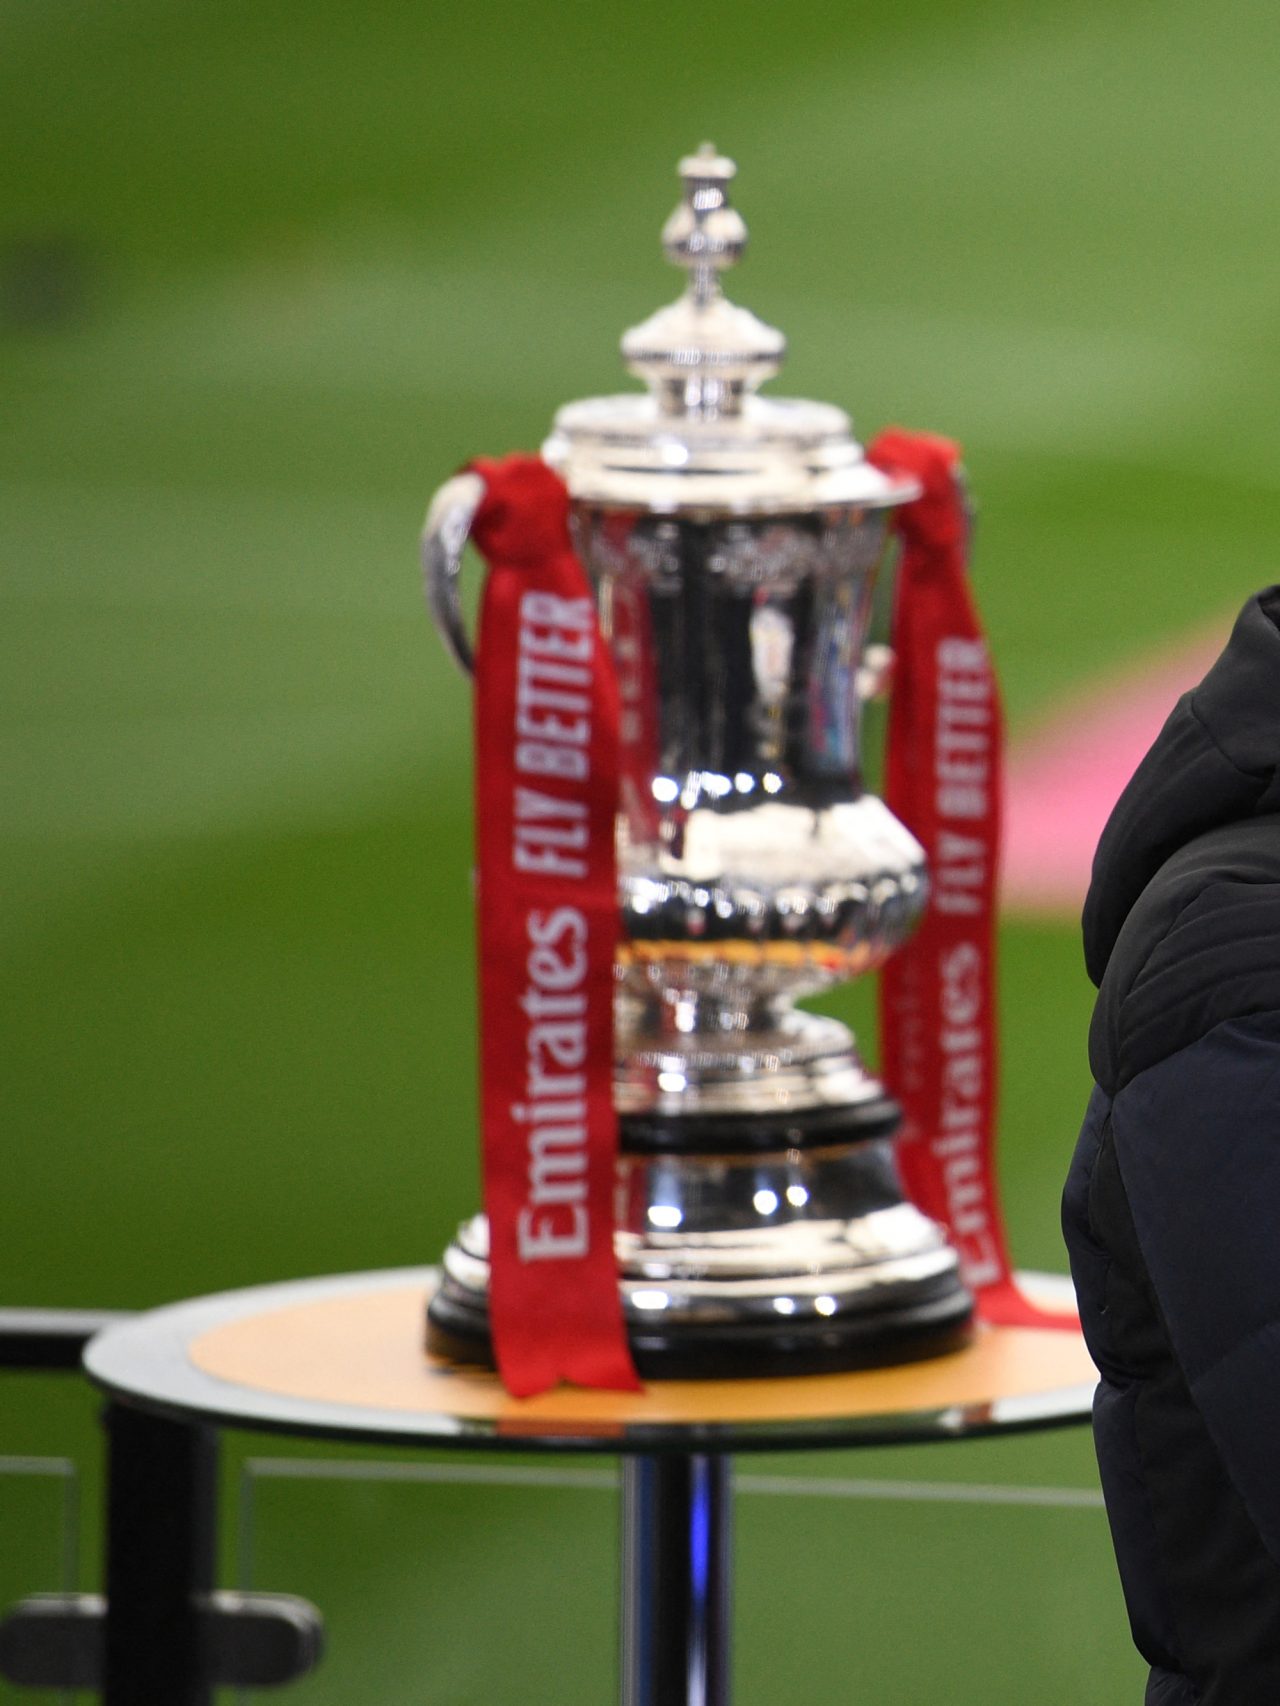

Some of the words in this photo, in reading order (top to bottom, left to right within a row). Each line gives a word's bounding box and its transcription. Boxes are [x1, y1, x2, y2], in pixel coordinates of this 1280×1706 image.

[515, 590, 594, 779] BETTER
[936, 638, 989, 818] BETTER
[513, 787, 588, 877] FLY
[936, 831, 985, 914] FLY
[512, 907, 590, 1261] Emirates
[932, 941, 999, 1286] Emirates
